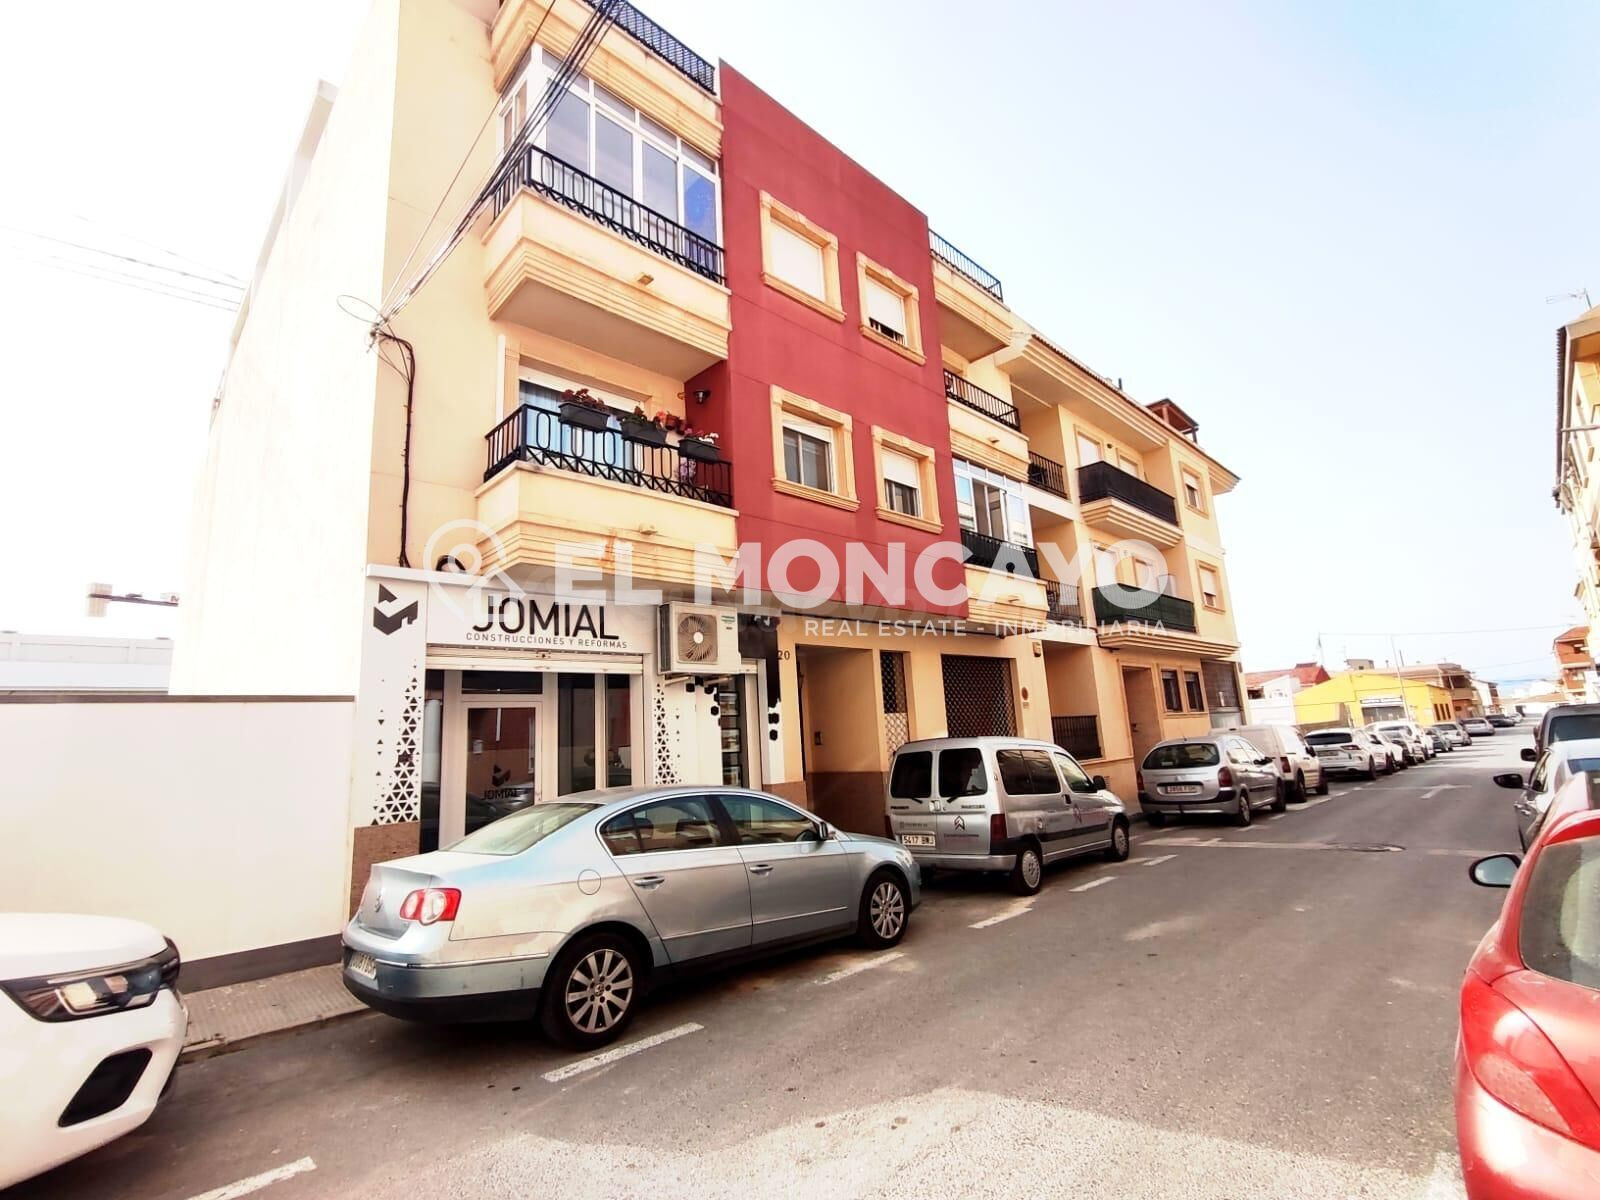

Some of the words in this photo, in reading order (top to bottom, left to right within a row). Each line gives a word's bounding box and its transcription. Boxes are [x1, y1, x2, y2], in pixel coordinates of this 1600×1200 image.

[473, 596, 619, 640] JOMIAL
[466, 632, 565, 646] CONSTRUCCIONES
[569, 638, 574, 646] Y
[578, 639, 628, 649] REFORMAS
[777, 650, 791, 660] 20
